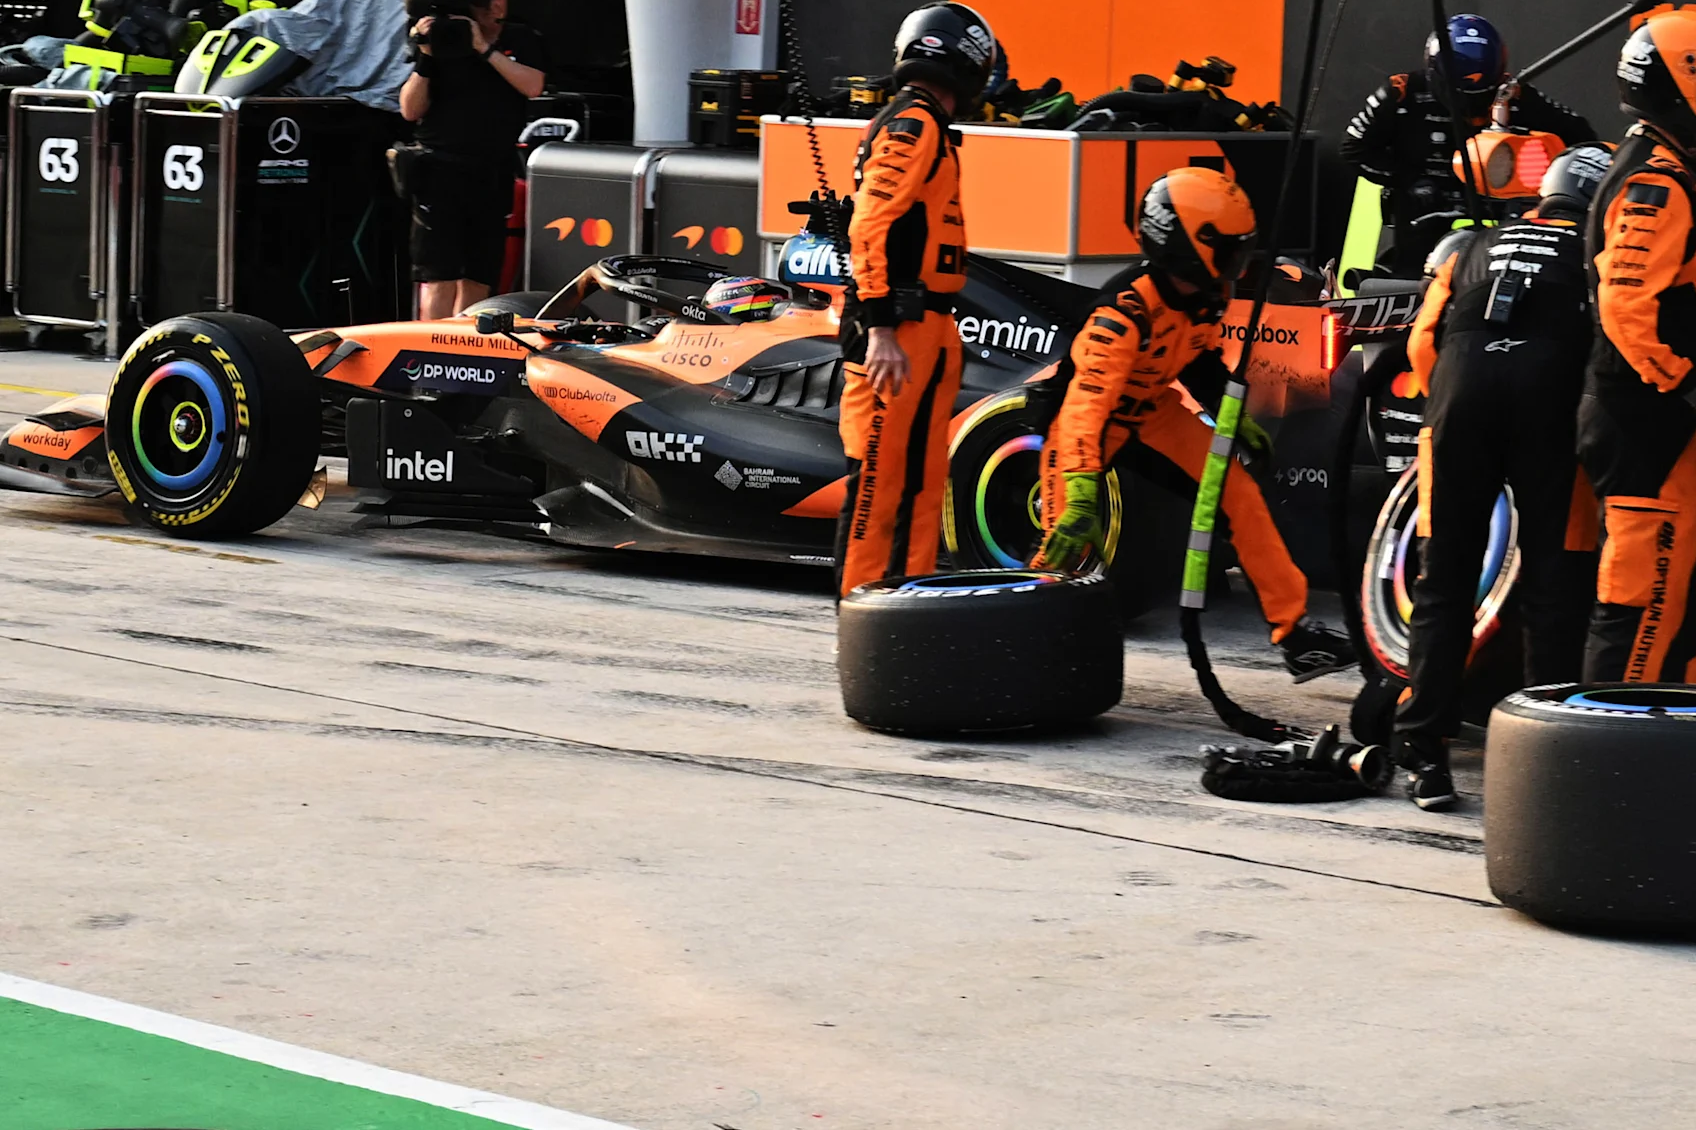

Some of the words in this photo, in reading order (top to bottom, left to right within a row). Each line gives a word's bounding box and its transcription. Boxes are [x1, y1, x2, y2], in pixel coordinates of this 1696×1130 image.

[39, 138, 80, 183] 63
[163, 145, 204, 191] 63
[682, 304, 706, 322] okta
[951, 306, 1059, 354] emini
[431, 333, 484, 349] RICHARD
[487, 337, 523, 352] MILLE
[661, 352, 712, 367] CISCO
[192, 333, 213, 345] P
[209, 345, 250, 429] ZERO
[423, 363, 444, 380] DP
[445, 365, 496, 383] WORLD
[558, 386, 617, 403] ClubAvolta
[23, 433, 72, 451] workday
[625, 431, 705, 463] OKX
[867, 415, 885, 472] OPTIMUM
[386, 448, 454, 482] intel
[743, 467, 774, 477] BAHRAIN
[744, 482, 770, 490] CIRCUIT
[748, 475, 801, 485] INTERNATIONAL
[1287, 467, 1328, 489] groq
[853, 475, 878, 541] NUTRITION
[1648, 557, 1671, 622] OPTIMUM
